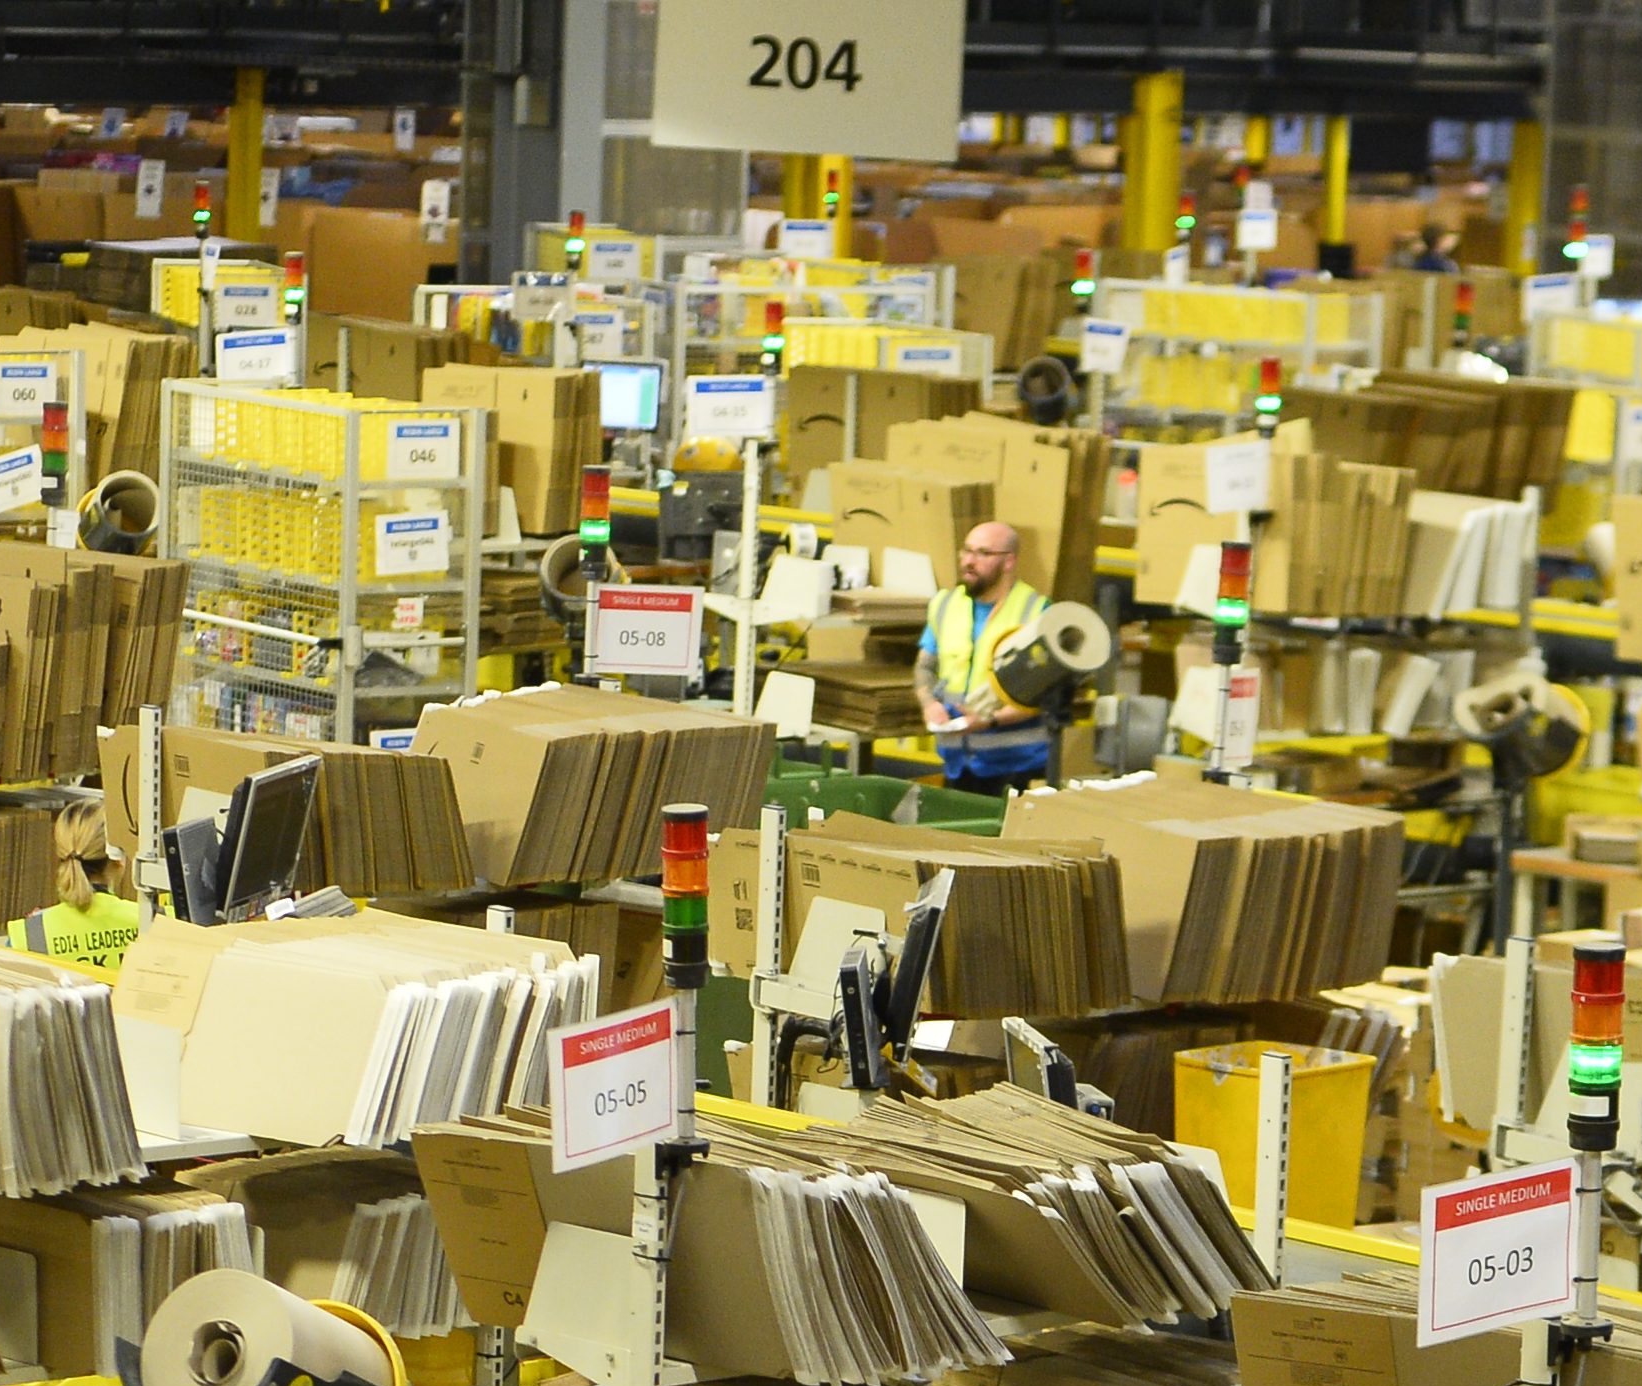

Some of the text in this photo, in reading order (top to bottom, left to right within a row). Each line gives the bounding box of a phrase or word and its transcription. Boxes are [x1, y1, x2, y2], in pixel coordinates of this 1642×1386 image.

[748, 35, 862, 92] 204
[12, 388, 37, 401] 060
[409, 449, 436, 463] 046
[612, 595, 679, 607] SINGLE MEDIUM
[619, 630, 666, 647] 05-08
[53, 937, 80, 955] EDI4
[579, 1021, 658, 1057] SINGLE MEDIUM
[593, 1079, 648, 1117] 05-05
[1455, 1181, 1552, 1217] SINGLE MEDIUM
[1468, 1245, 1535, 1286] 05-03
